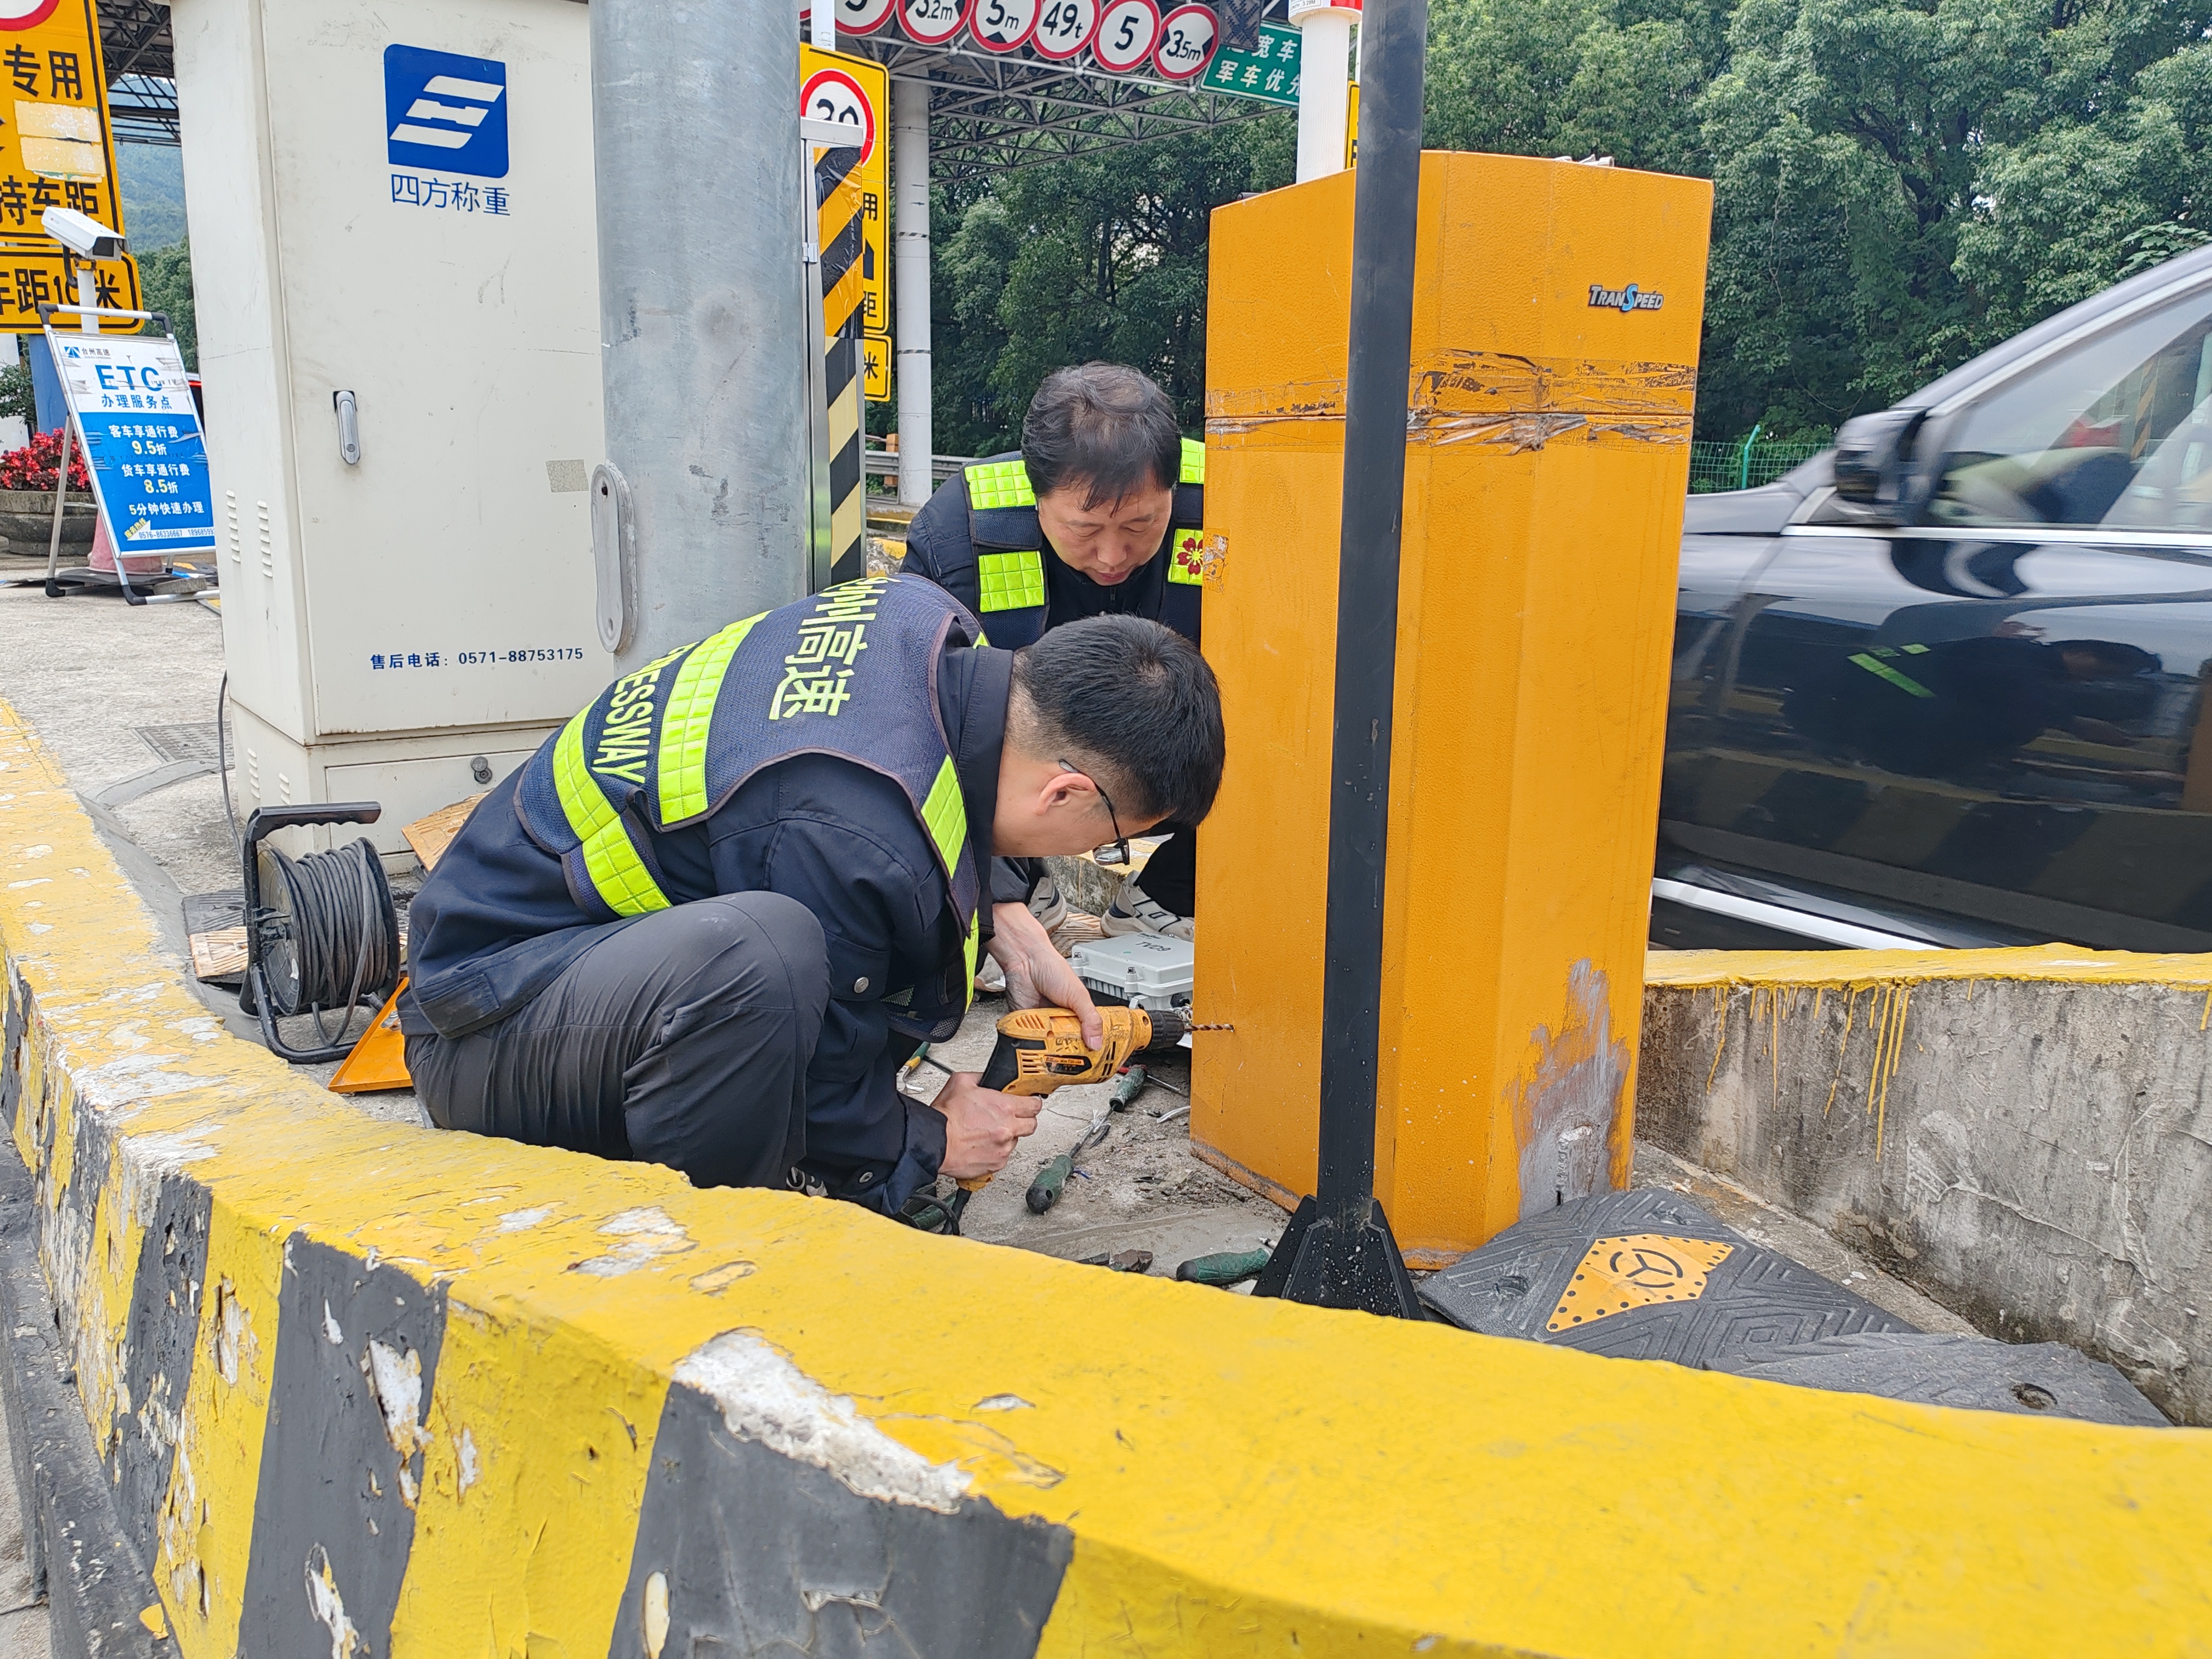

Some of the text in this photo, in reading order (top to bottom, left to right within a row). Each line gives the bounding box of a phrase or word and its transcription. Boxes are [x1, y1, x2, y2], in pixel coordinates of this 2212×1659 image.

[1042, 2, 1083, 39] 49t
[1114, 15, 1139, 50] 5
[1166, 30, 1201, 62] 3.5m
[3, 44, 83, 101] 专用
[391, 174, 511, 217] 四方称重
[95, 365, 163, 391] ETC
[101, 393, 172, 409] 办理服务点
[108, 425, 179, 438] 客车享通行费
[132, 440, 168, 456] 9.5折
[121, 463, 191, 477] 货车享通行费
[144, 479, 179, 494] 8.5折
[128, 501, 205, 516] 5分钟快速办理
